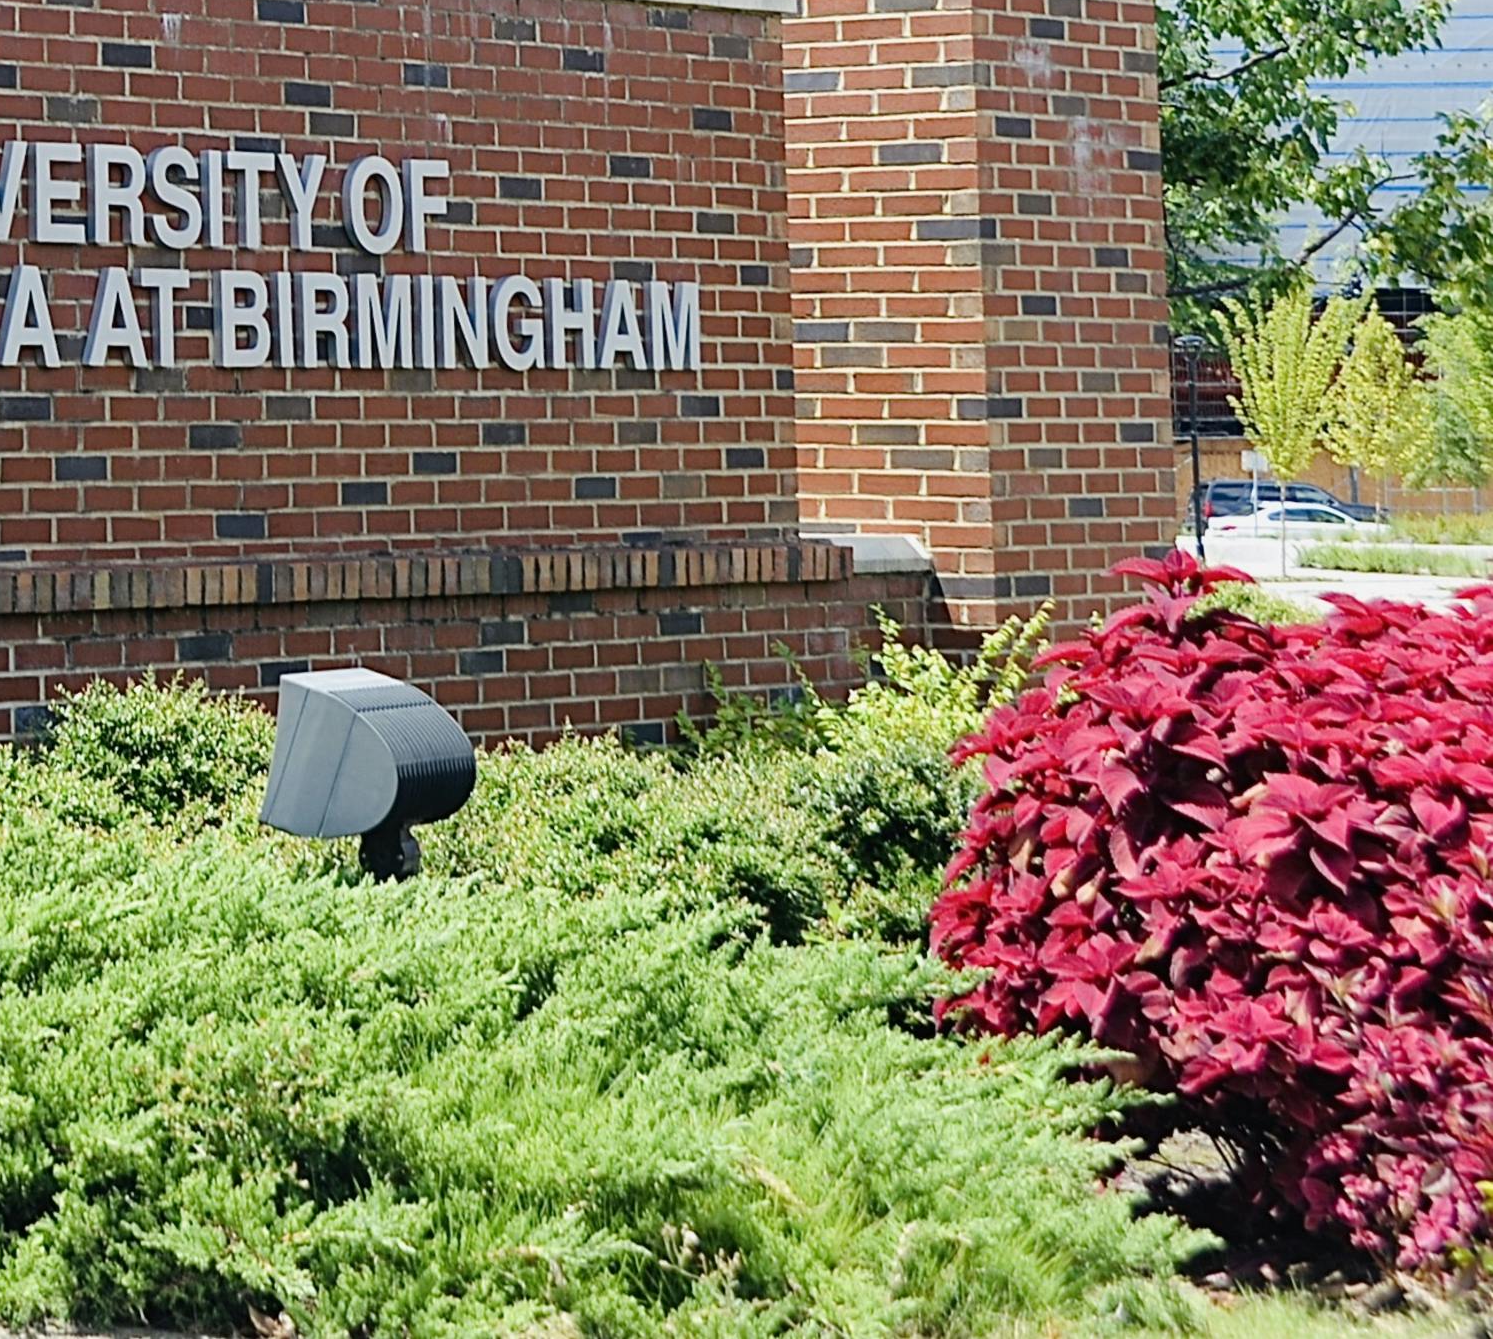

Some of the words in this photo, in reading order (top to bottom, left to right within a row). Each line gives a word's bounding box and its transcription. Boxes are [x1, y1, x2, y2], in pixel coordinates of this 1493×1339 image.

[342, 155, 450, 256] OF
[81, 266, 191, 369] AT
[214, 269, 701, 372] BIRMINGHAM
